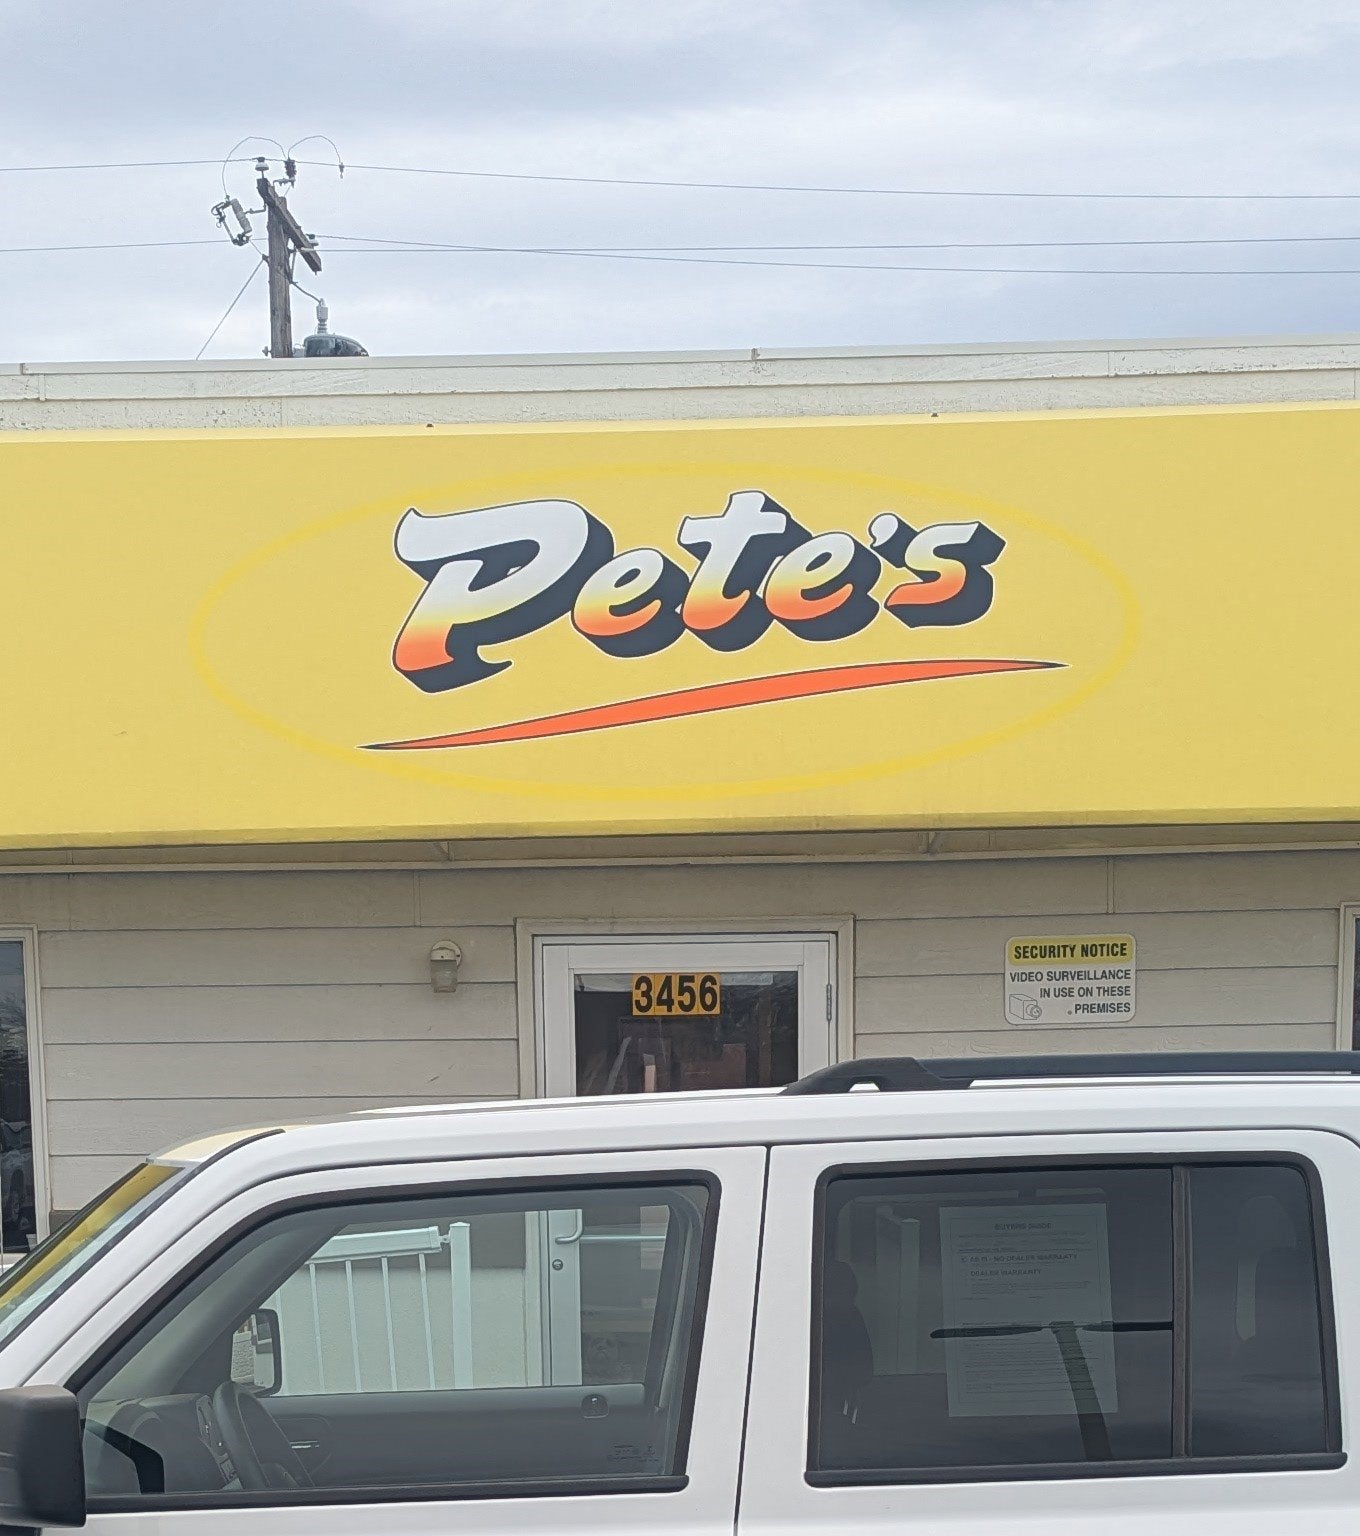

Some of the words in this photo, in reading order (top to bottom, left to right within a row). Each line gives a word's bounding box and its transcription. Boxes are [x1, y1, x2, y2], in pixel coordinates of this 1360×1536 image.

[393, 489, 1006, 694] Pete's
[1014, 945, 1077, 960] SECURITY
[1080, 943, 1128, 957] NOTICE
[1009, 971, 1043, 983] VIDEO
[1046, 969, 1132, 982] SURVEILLANCE
[634, 974, 718, 1013] 3456
[1040, 987, 1051, 998] IN
[1053, 987, 1075, 998] USE
[1077, 986, 1094, 997] ON
[1096, 985, 1131, 997] THESE
[1074, 1002, 1131, 1015] PREMISES
